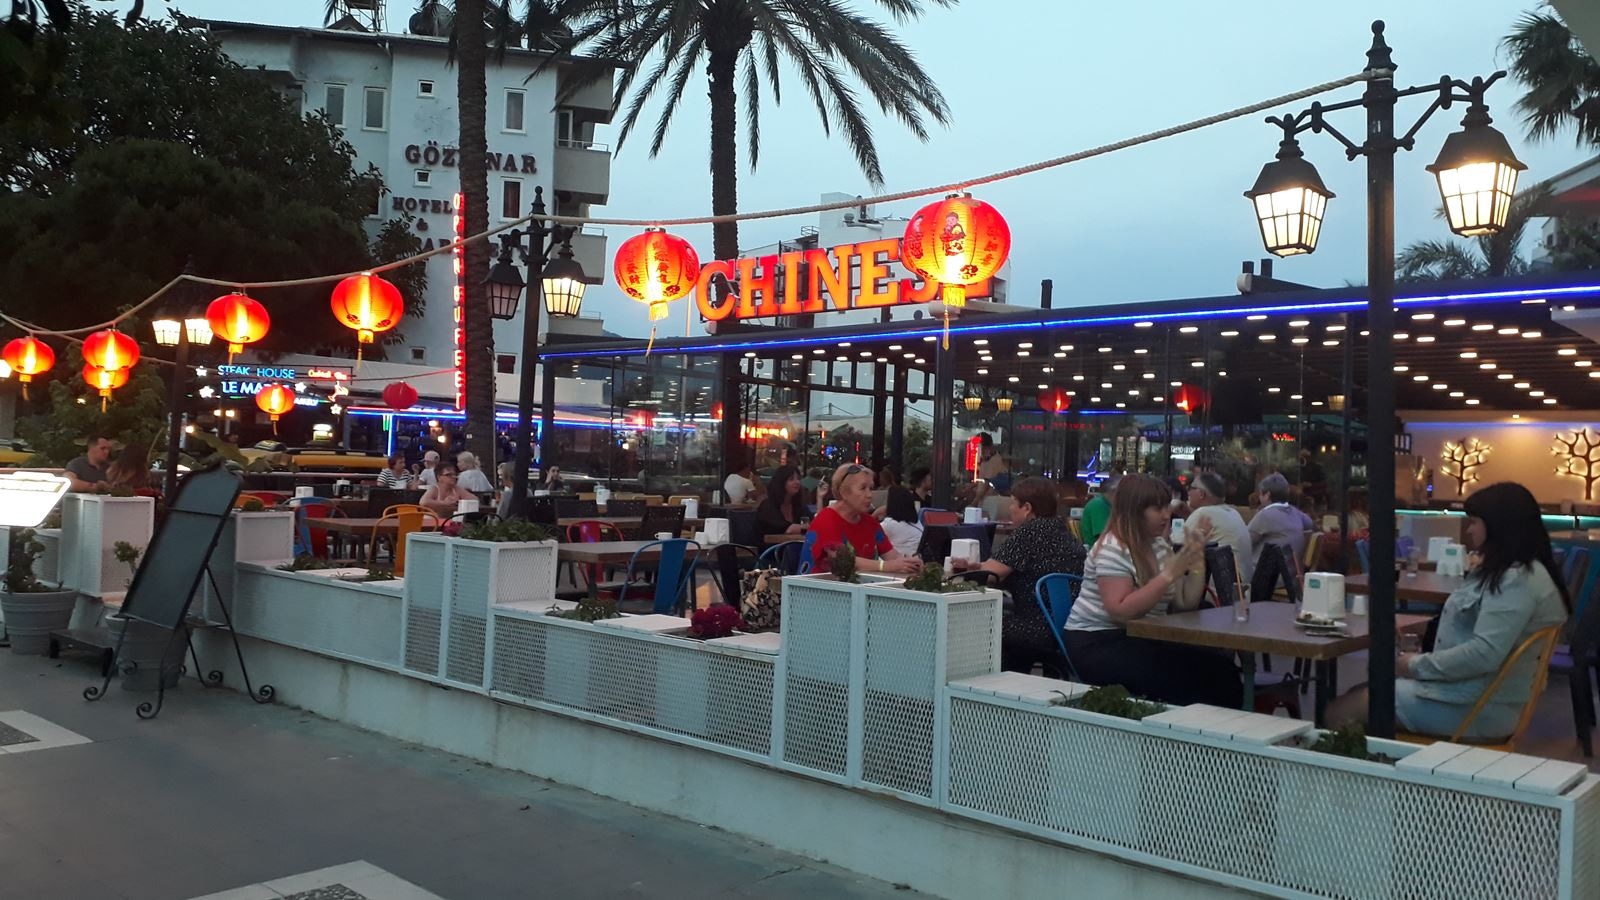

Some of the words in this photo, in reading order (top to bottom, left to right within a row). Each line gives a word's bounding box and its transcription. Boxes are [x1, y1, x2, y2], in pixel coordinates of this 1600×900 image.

[405, 140, 538, 175] GÖZNAR
[392, 196, 453, 215] HOTEL
[416, 217, 429, 232] &
[695, 237, 991, 321] CHINE
[217, 364, 251, 376] STEAK
[256, 368, 296, 379] HOUSE
